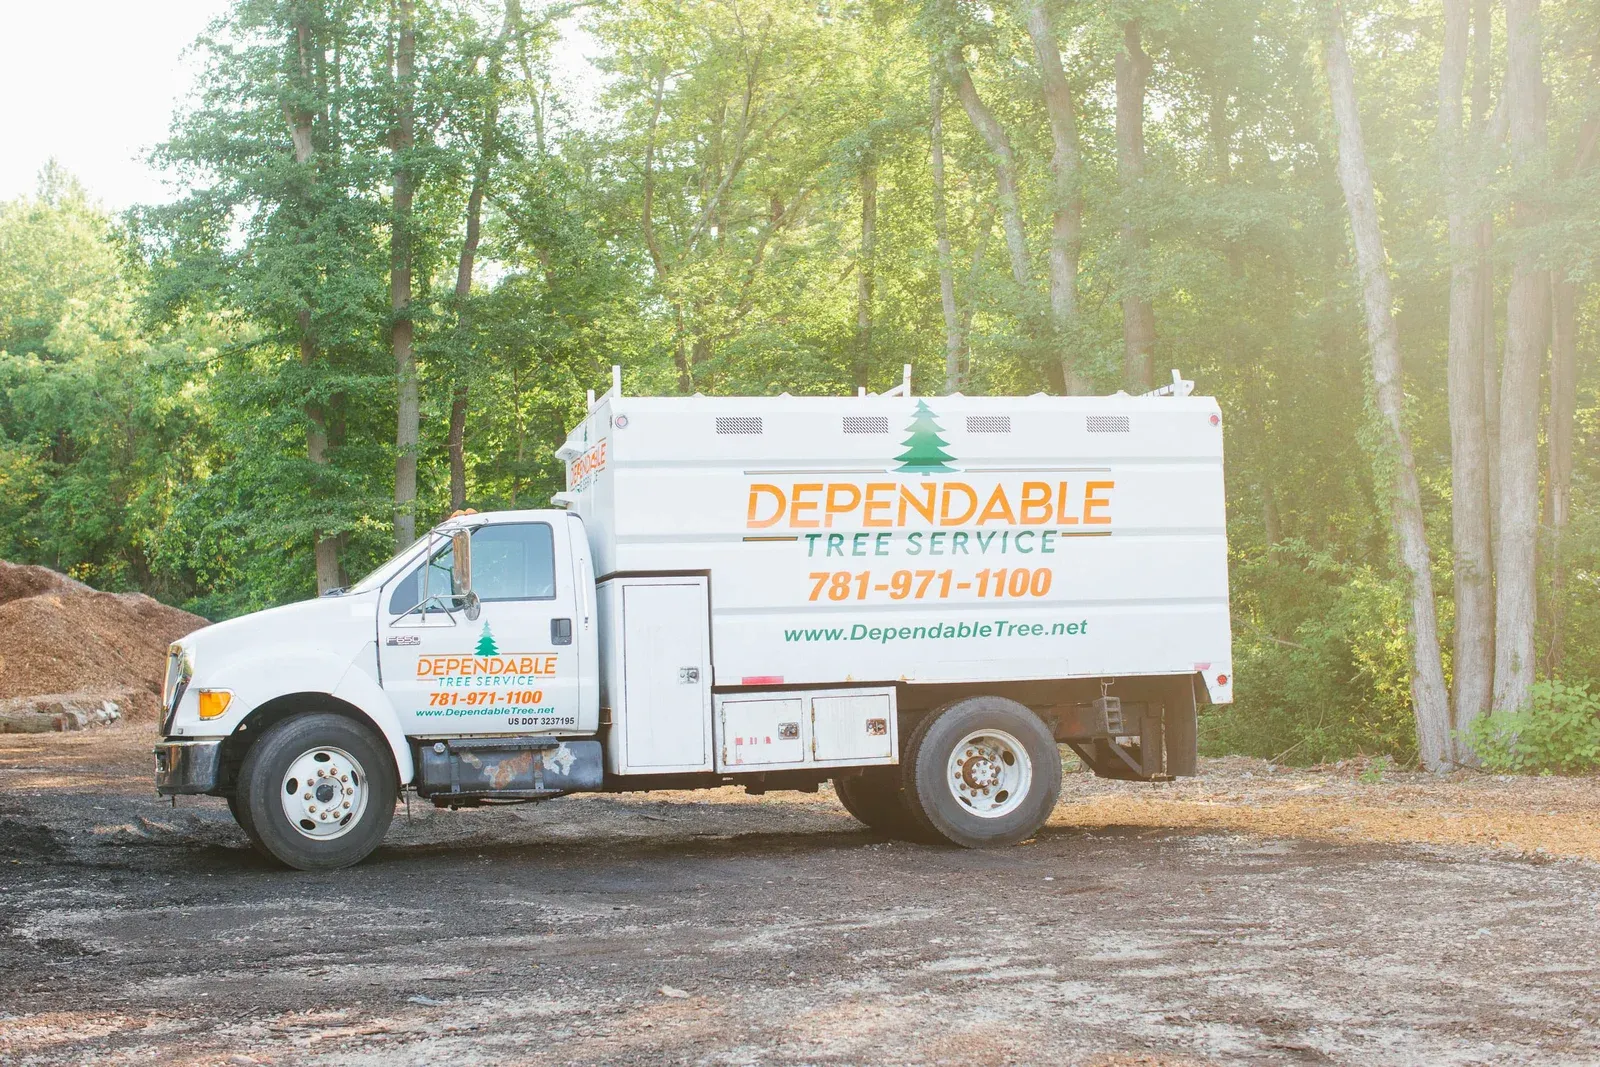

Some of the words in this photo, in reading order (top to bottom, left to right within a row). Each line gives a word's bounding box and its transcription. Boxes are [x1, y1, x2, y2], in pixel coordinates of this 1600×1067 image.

[747, 481, 1115, 529] DEPENDABLE
[805, 532, 892, 557] TREE
[906, 530, 1057, 555] SERVICE
[808, 567, 1052, 601] 781-971-1100
[784, 619, 1088, 644] www.DependableTree.net
[417, 657, 557, 676] DEPENDABLE
[438, 676, 471, 687] TREE
[477, 675, 535, 686] SERVICE
[429, 690, 543, 706] 781-971-1100
[415, 706, 555, 718] www.DependableTree.net
[508, 718, 519, 726] US
[521, 717, 539, 726] DOT
[540, 716, 575, 725] 3237195
